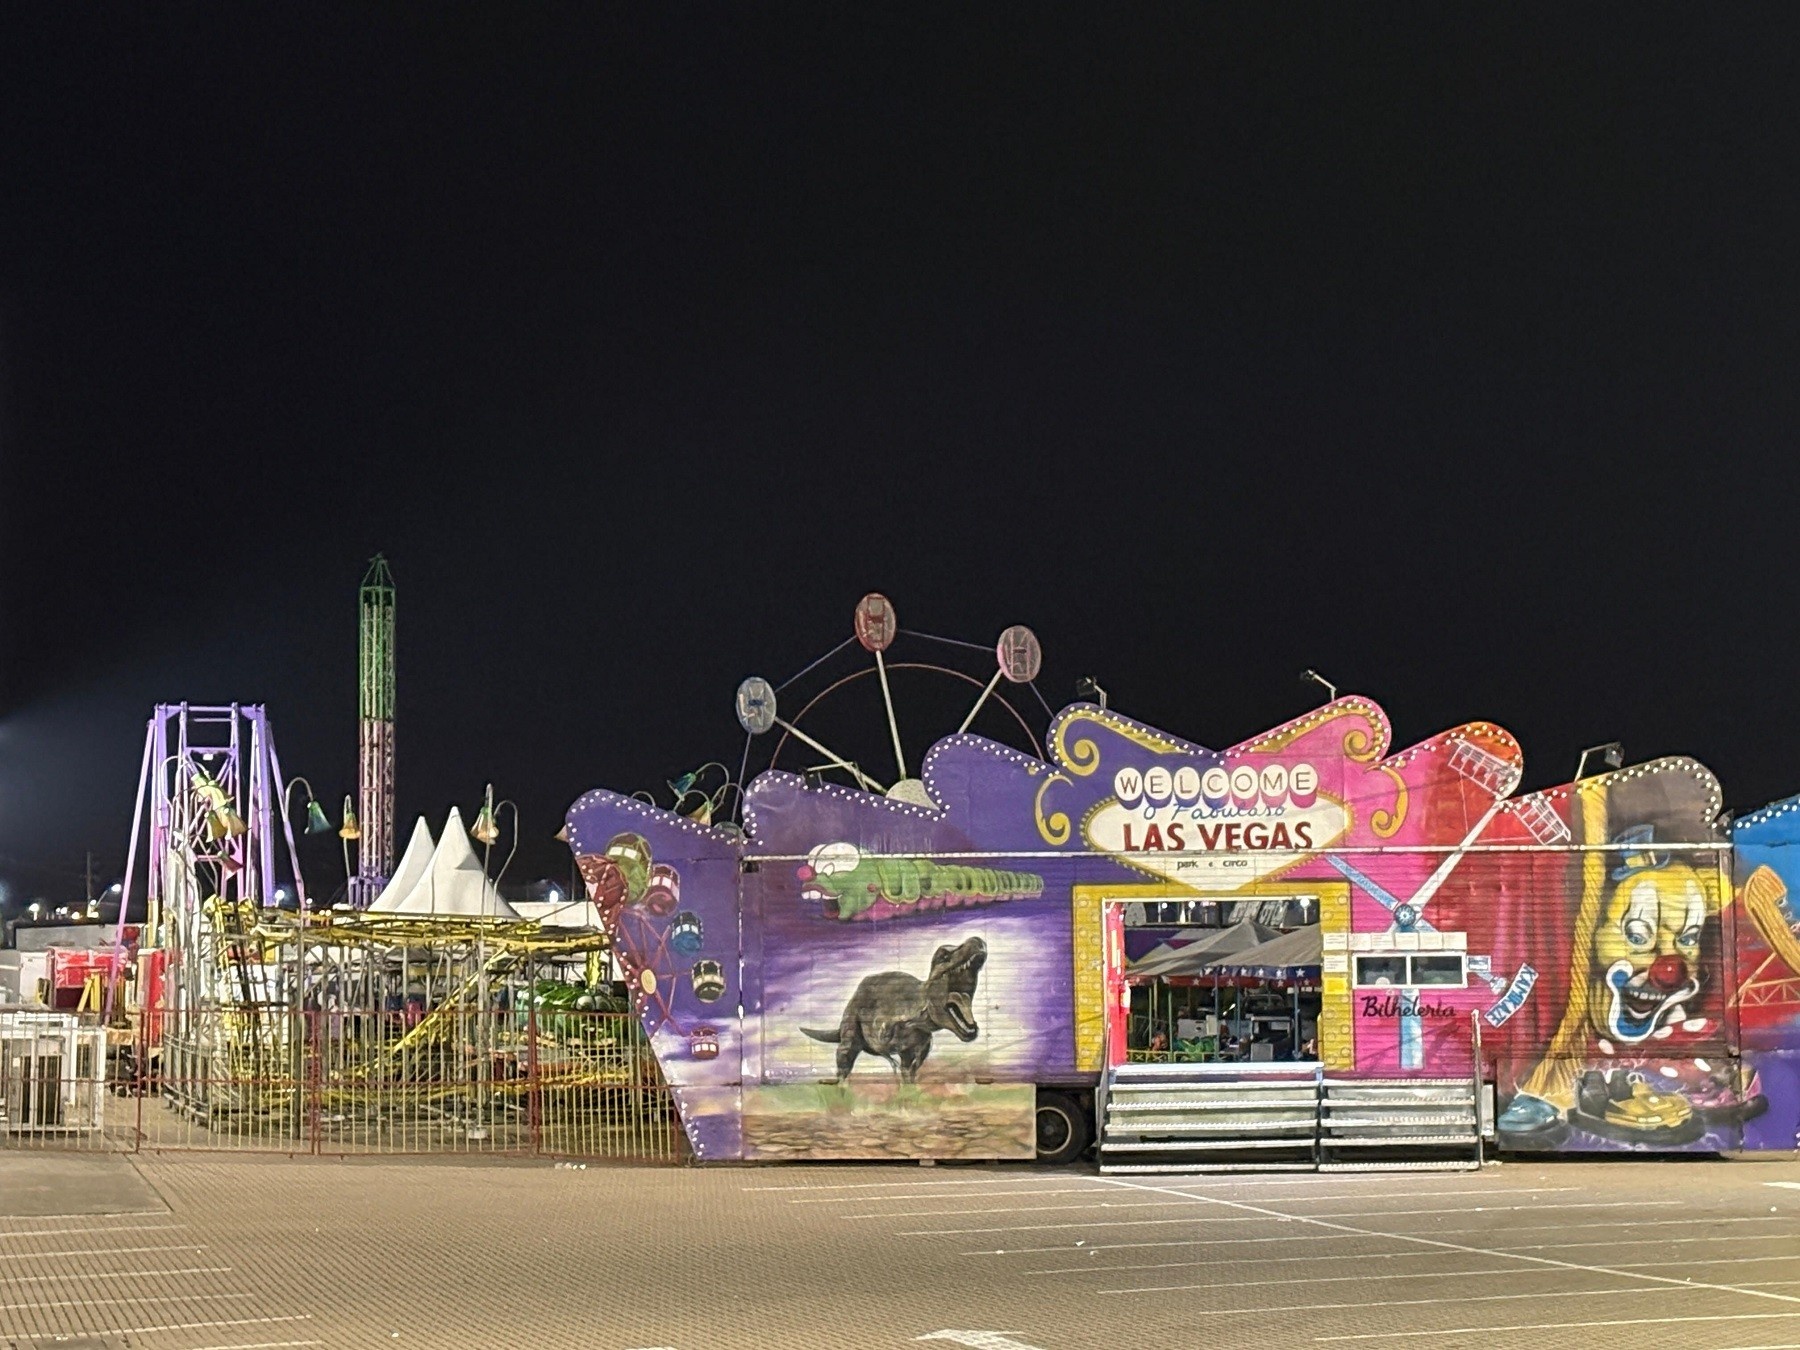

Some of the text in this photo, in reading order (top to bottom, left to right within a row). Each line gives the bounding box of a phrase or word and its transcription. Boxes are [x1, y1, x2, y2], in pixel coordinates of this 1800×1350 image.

[1119, 770, 1312, 795] WELCOME
[1122, 821, 1313, 851] LAS VEGAS
[1485, 963, 1537, 1026] KAMIKAZE
